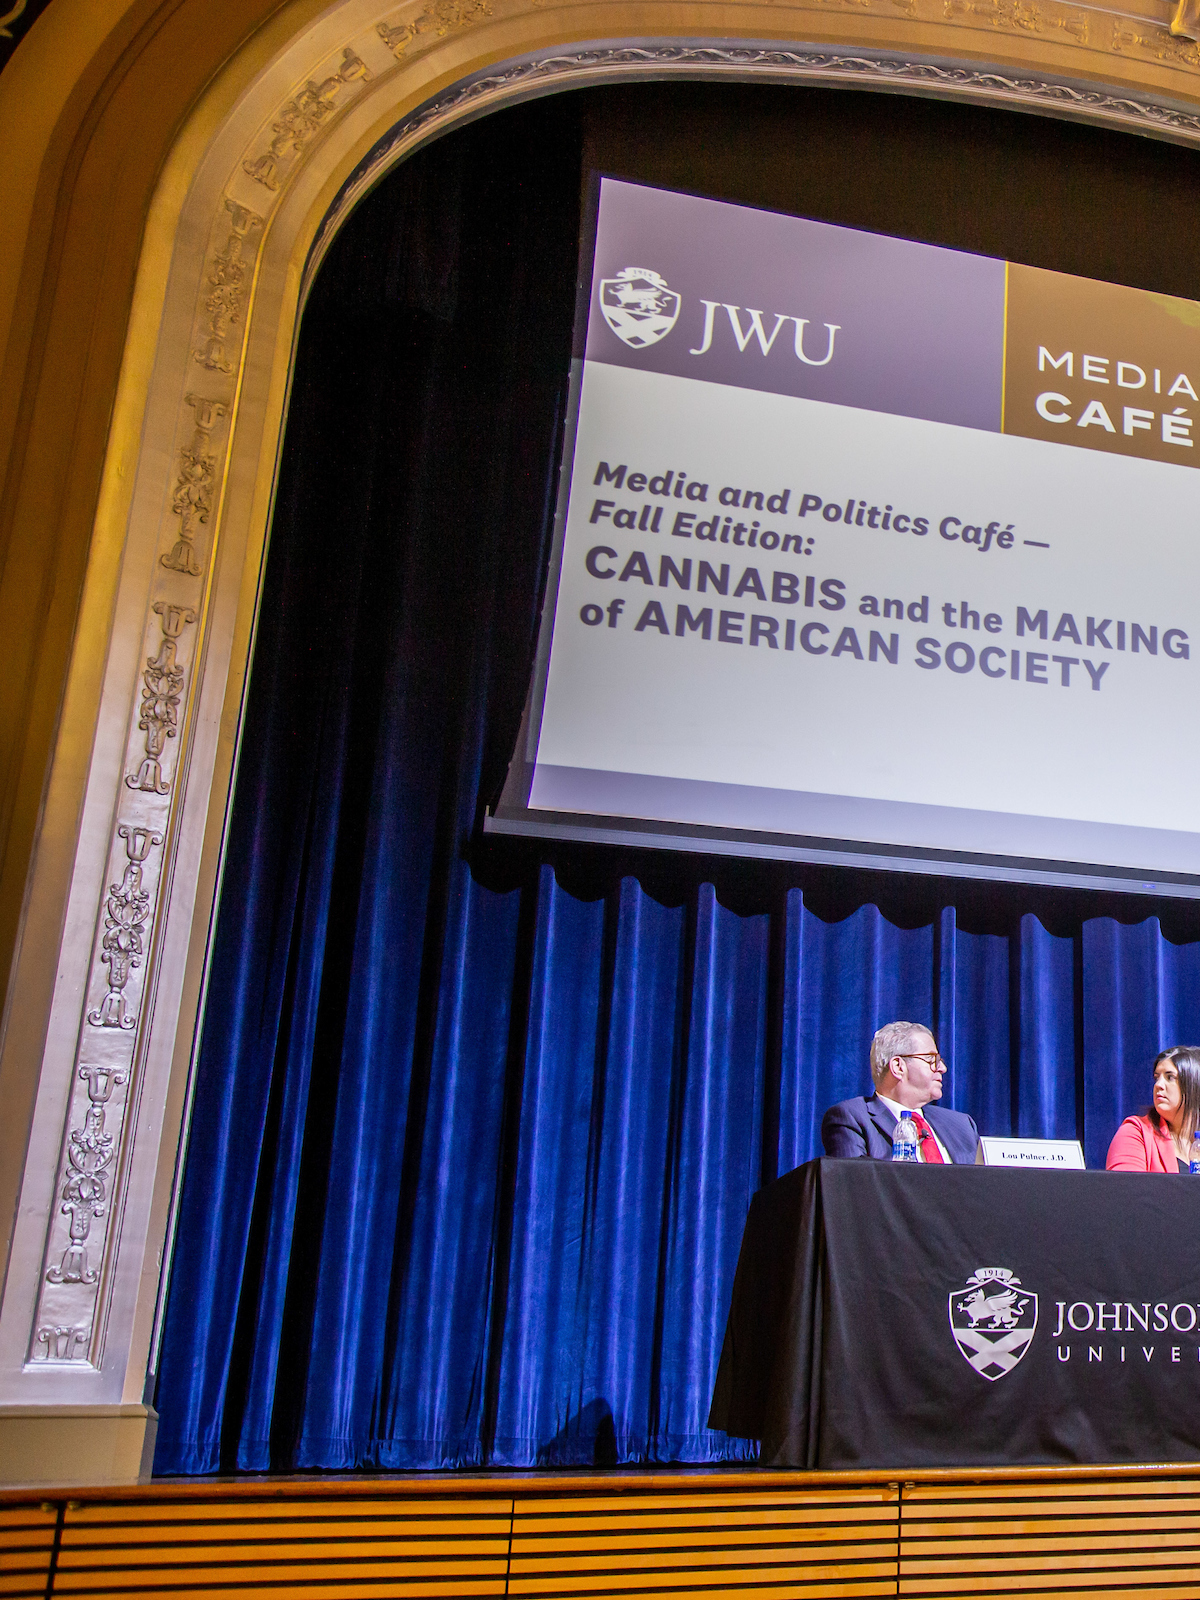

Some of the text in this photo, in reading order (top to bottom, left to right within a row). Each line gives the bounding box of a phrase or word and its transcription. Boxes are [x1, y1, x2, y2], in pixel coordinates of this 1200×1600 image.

[689, 299, 842, 366] JWU
[1038, 346, 1199, 401] MEDIA
[1035, 391, 1195, 447] CAFÉ
[589, 498, 816, 556] Fall Edition:
[593, 461, 709, 502] Media
[718, 481, 790, 515] and
[798, 493, 930, 537] Politics
[938, 515, 1016, 552] Café
[583, 545, 1192, 661] CANNABIS and the MAKING
[579, 599, 1111, 692] of AMERICAN SOCIETY
[1020, 1153, 1049, 1161] Pulner,
